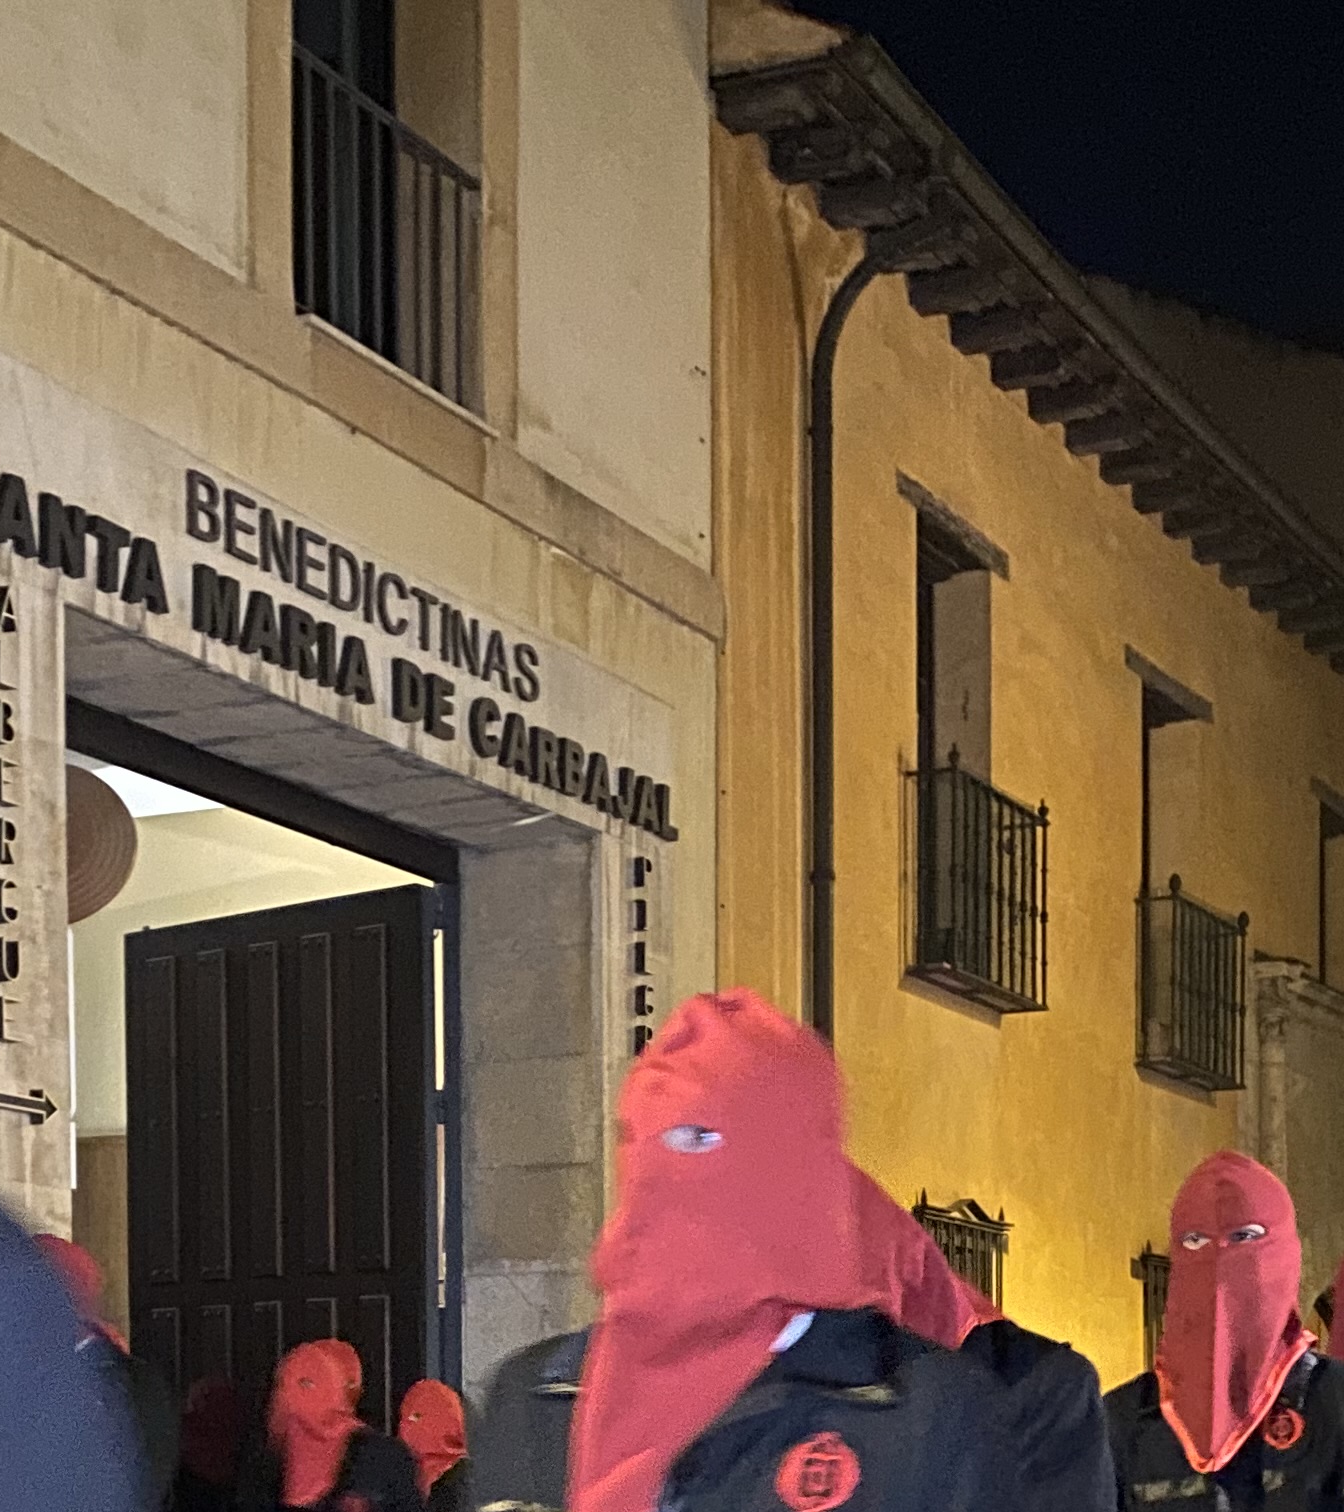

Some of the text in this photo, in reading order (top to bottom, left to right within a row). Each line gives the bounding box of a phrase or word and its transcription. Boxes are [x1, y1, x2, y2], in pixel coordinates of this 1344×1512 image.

[185, 468, 542, 703] BENEDICTINAS
[192, 562, 376, 705] MARIA
[391, 656, 456, 741] DE
[468, 696, 679, 842] CARBAJAL
